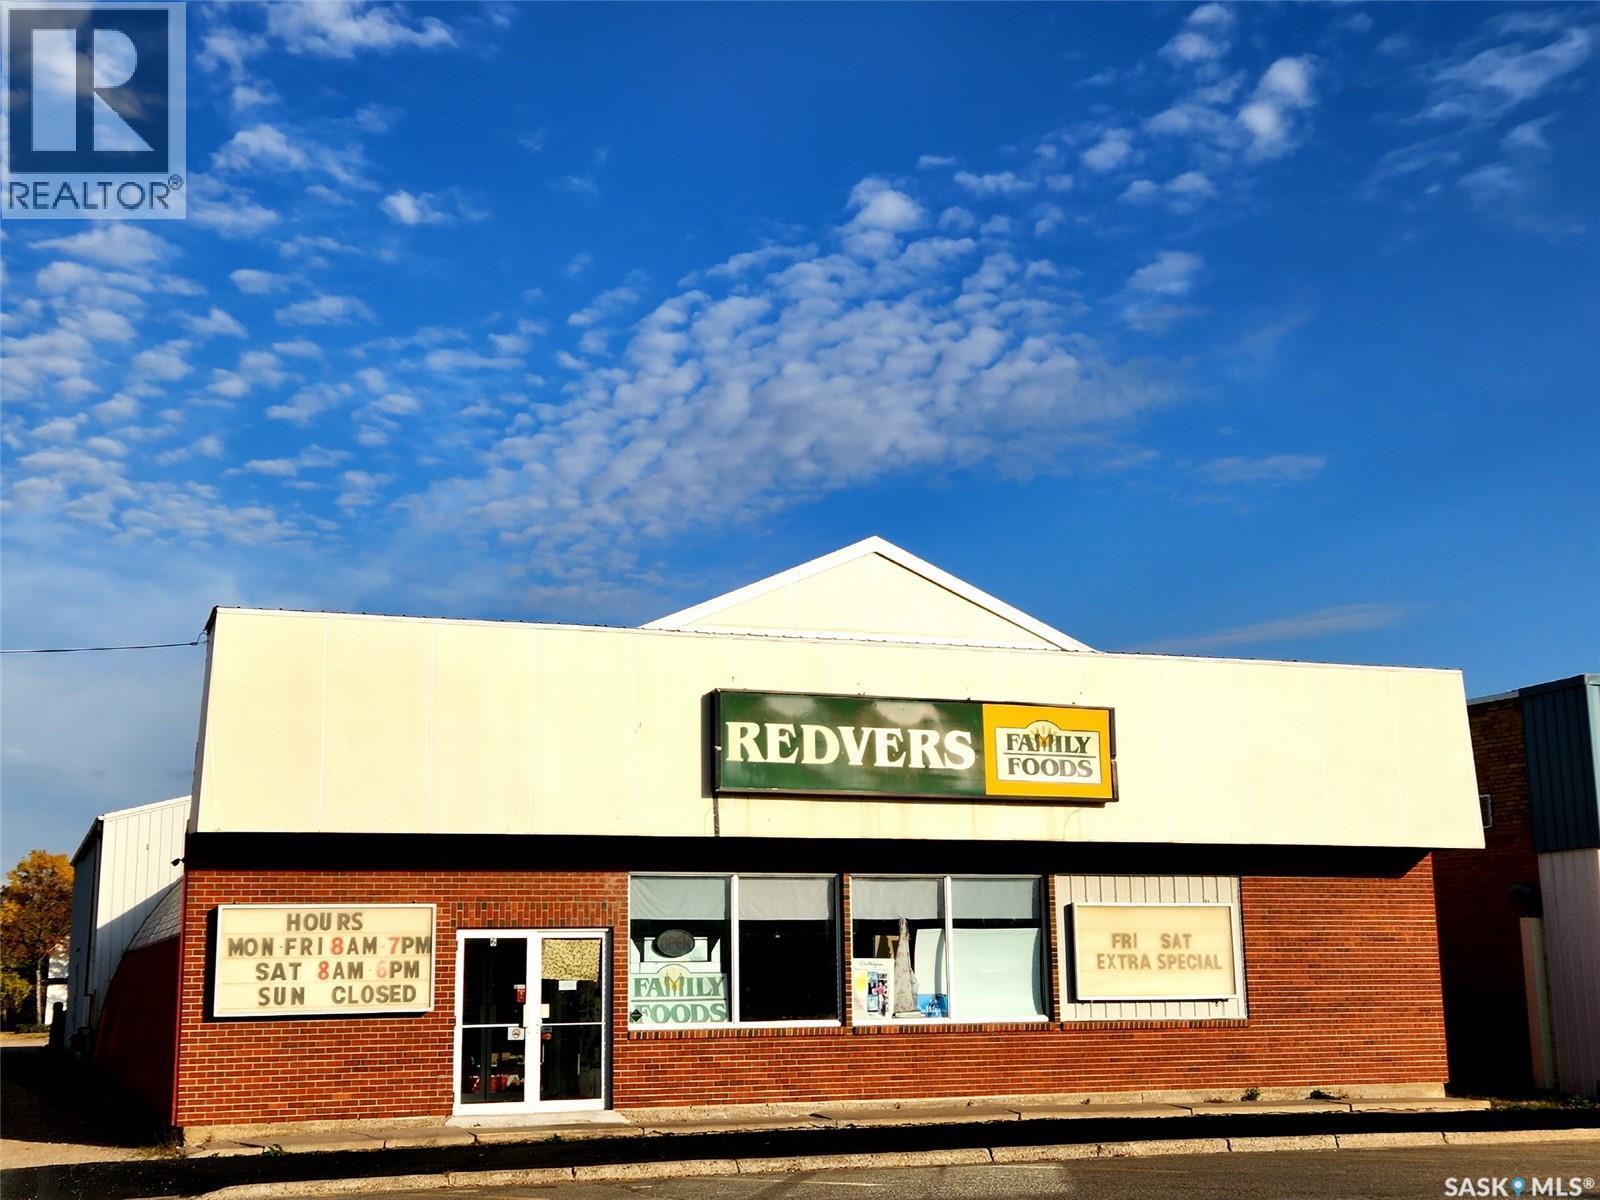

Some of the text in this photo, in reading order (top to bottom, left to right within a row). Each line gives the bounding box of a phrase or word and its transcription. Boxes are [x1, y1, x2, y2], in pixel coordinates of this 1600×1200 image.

[725, 721, 976, 770] REDVERS
[1006, 733, 1091, 754] FAMILY
[1007, 757, 1093, 778] FOODS
[286, 912, 363, 931] HOURS
[1111, 932, 1192, 949] FRI SAT
[255, 962, 302, 981] SAT
[1096, 953, 1223, 970] EXTRA SPECIAL
[258, 984, 417, 1006] SUN CLOSED
[633, 976, 725, 998] FAMILY
